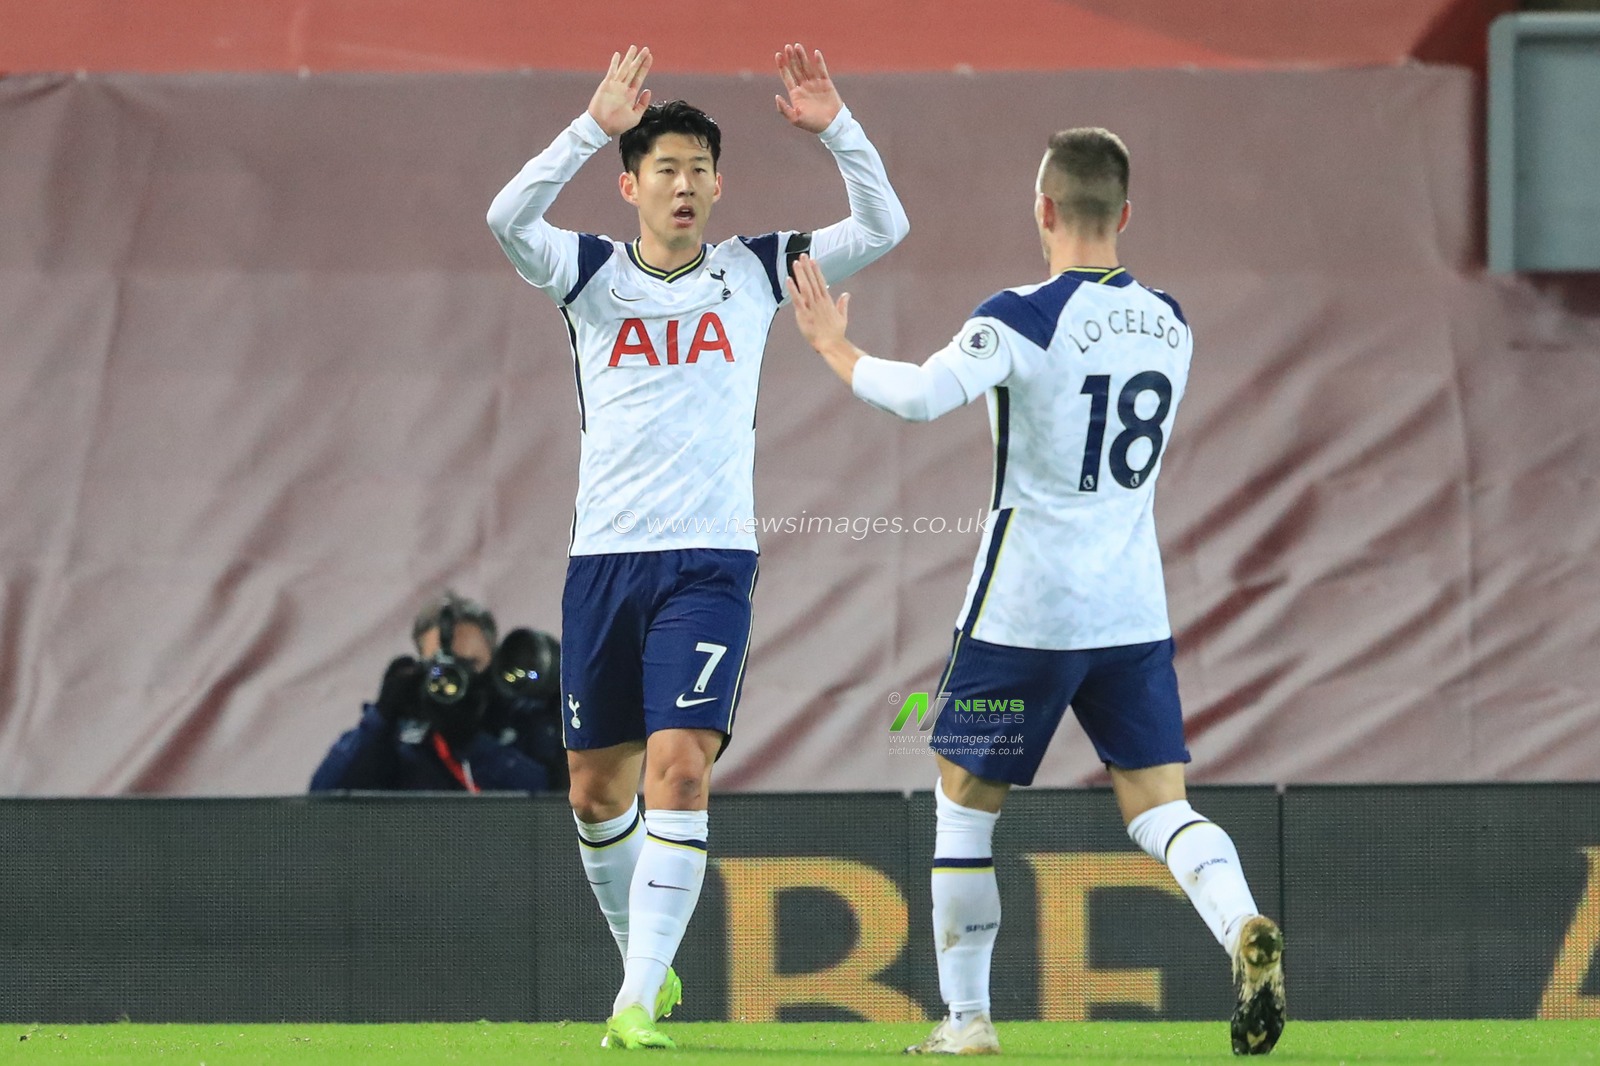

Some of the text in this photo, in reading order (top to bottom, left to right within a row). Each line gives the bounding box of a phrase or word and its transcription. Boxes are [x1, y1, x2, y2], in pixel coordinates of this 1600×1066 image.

[607, 312, 735, 367] AIA
[1069, 309, 1180, 353] LO CELSO
[1079, 370, 1172, 492] 18
[695, 642, 727, 693] 7
[1194, 858, 1229, 875] SPURS
